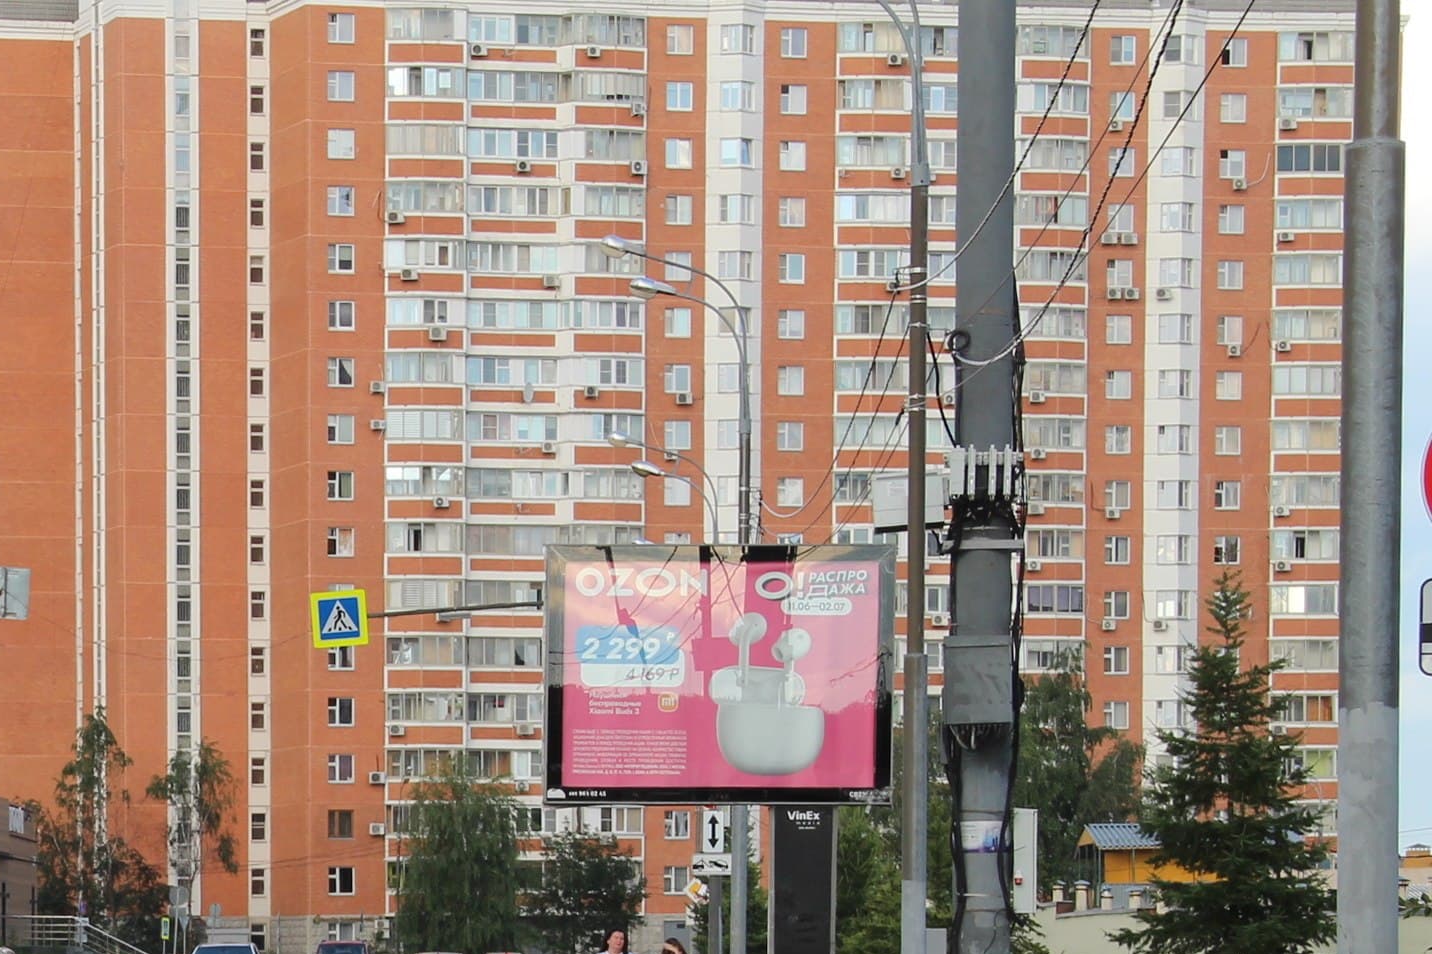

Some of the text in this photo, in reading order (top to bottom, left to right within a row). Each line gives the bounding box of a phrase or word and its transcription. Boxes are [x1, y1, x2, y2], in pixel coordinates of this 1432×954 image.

[575, 567, 709, 597] OZON
[809, 569, 868, 584] РАСПРО
[807, 583, 866, 597] ДАЖА
[606, 637, 661, 660] 299
[787, 810, 820, 820] VinEx
